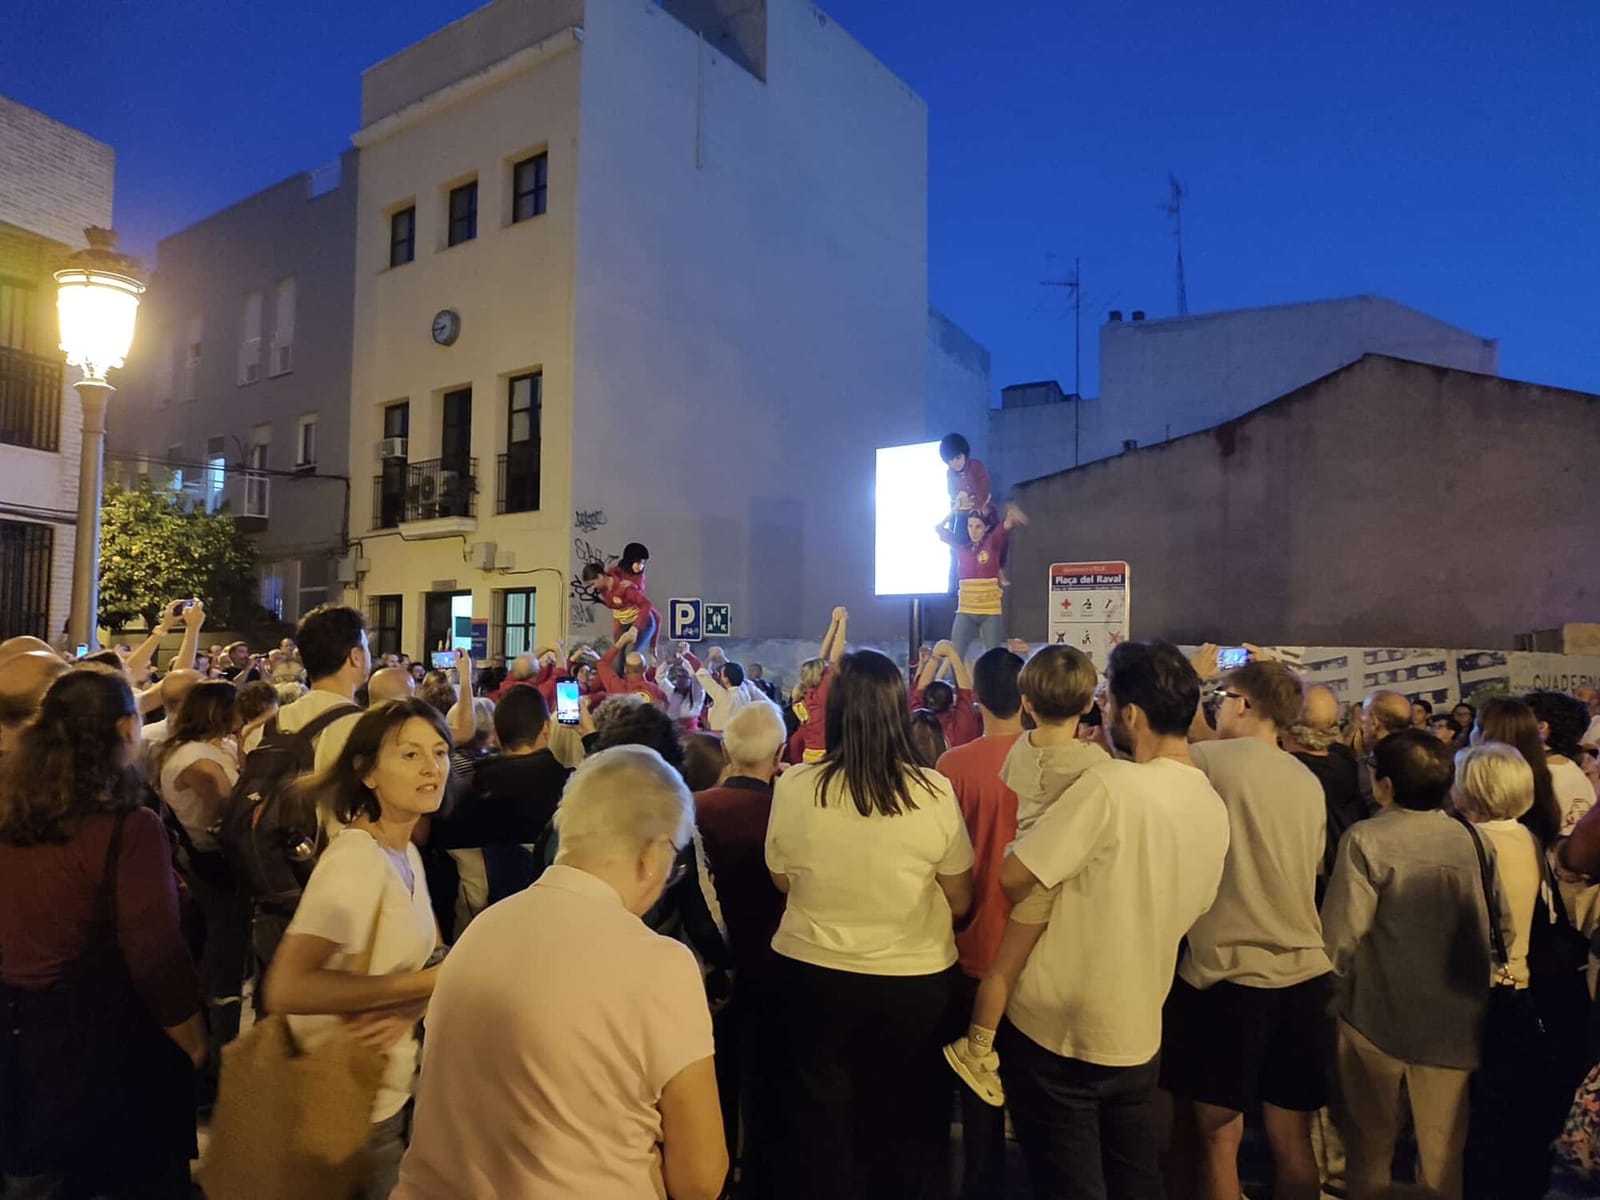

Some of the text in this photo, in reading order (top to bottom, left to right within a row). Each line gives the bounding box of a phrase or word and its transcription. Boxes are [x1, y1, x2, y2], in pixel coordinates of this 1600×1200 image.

[1056, 574, 1122, 585] Plaça del Raval
[675, 603, 695, 636] P
